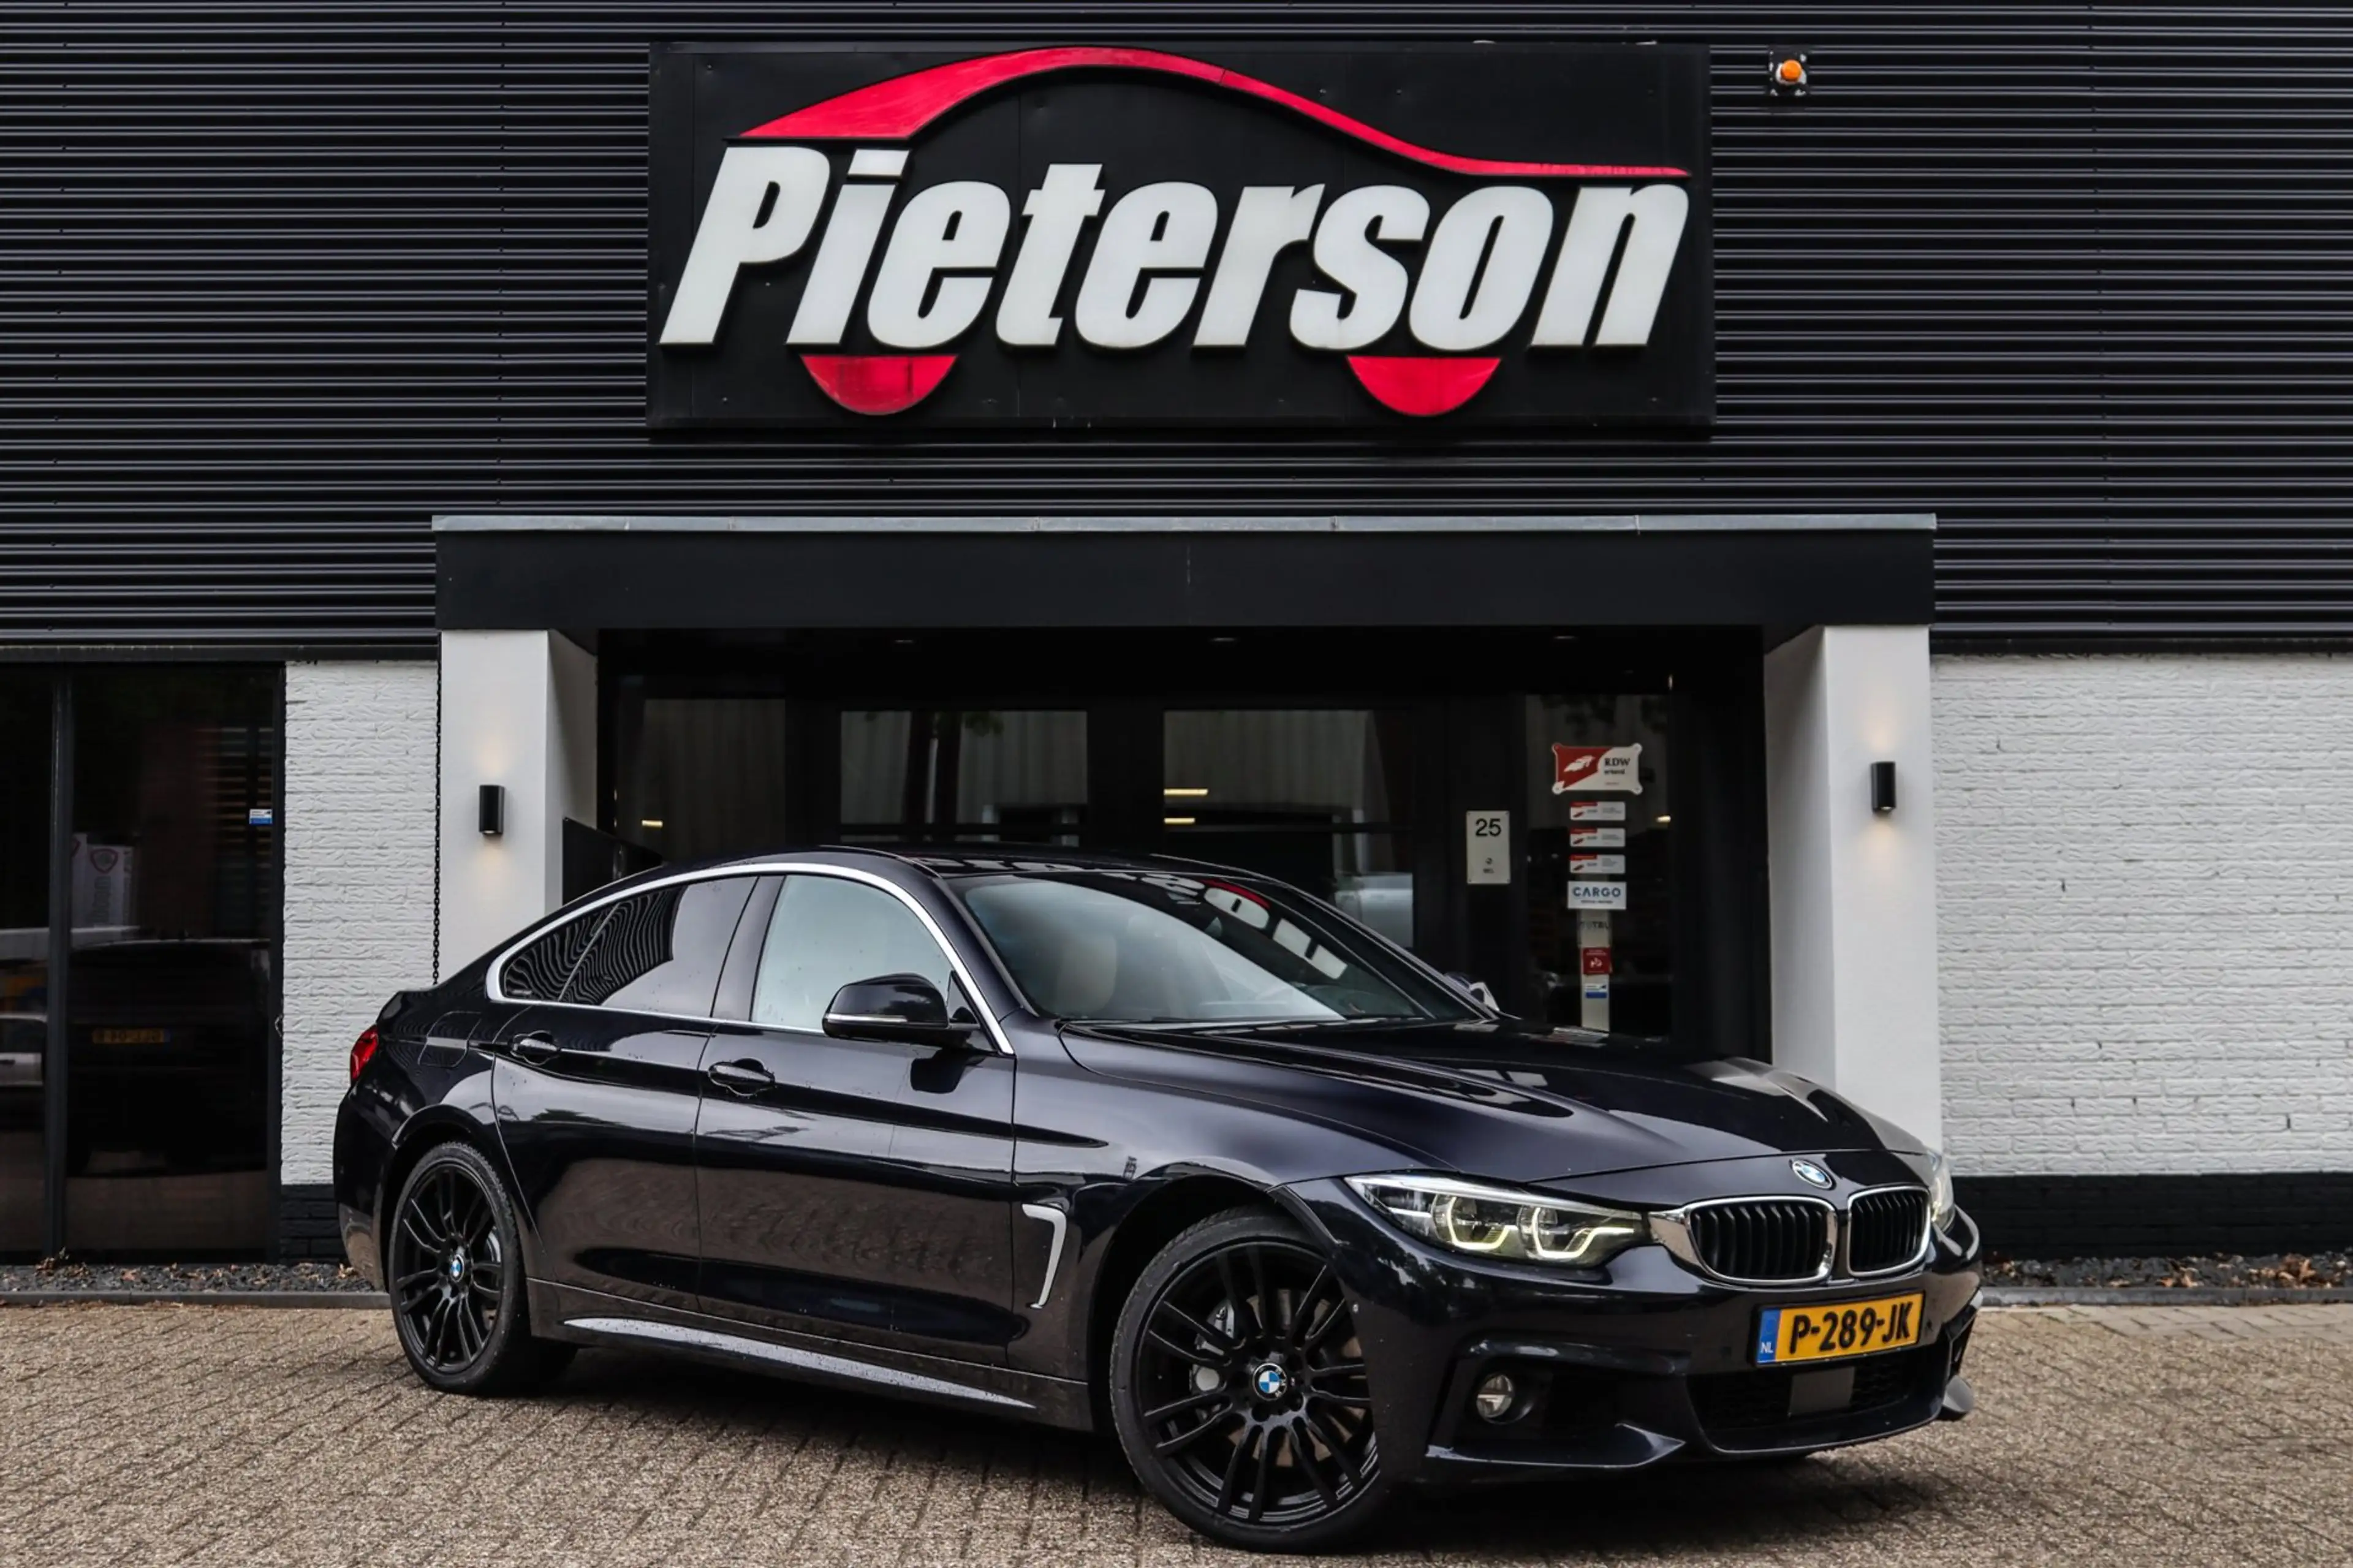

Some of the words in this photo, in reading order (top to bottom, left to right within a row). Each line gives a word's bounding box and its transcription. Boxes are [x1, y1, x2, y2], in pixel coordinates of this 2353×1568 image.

[660, 146, 1689, 348] Pieterson
[1604, 757, 1631, 767] RDW
[1475, 817, 1501, 837] 25
[1572, 886, 1621, 898] CARGO
[1789, 1301, 1914, 1354] P-289-JK
[1760, 1342, 1774, 1354] NL
